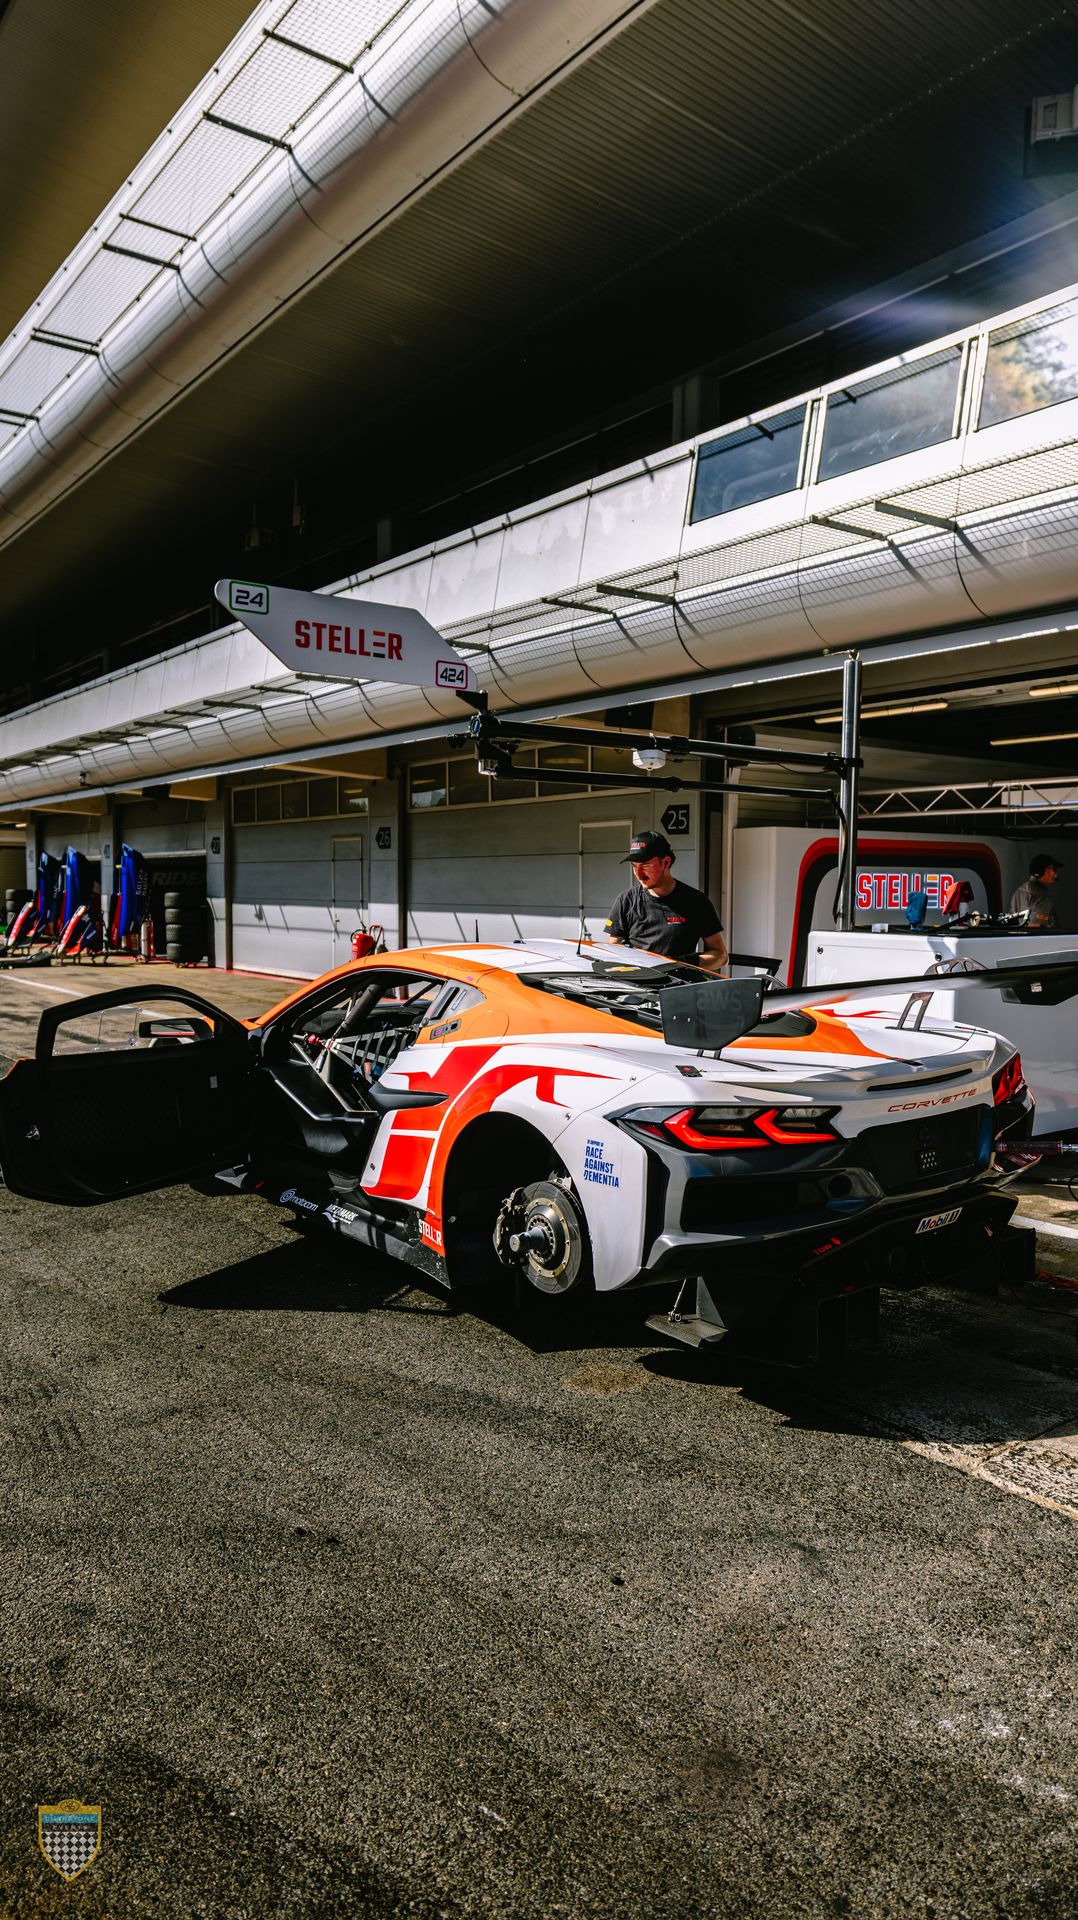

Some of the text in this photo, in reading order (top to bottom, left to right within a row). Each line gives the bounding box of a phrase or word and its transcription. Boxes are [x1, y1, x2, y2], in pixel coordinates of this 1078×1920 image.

[235, 589, 264, 608] 24
[295, 620, 403, 661] STELLER
[439, 667, 465, 683] 424
[667, 810, 688, 830] 25
[379, 831, 391, 846] 26
[887, 1088, 978, 1113] CORVETTE
[585, 1146, 604, 1160] RACE
[584, 1157, 614, 1174] AGAINST
[583, 1170, 620, 1188] DEMENTIA
[918, 1213, 951, 1232] Mobil
